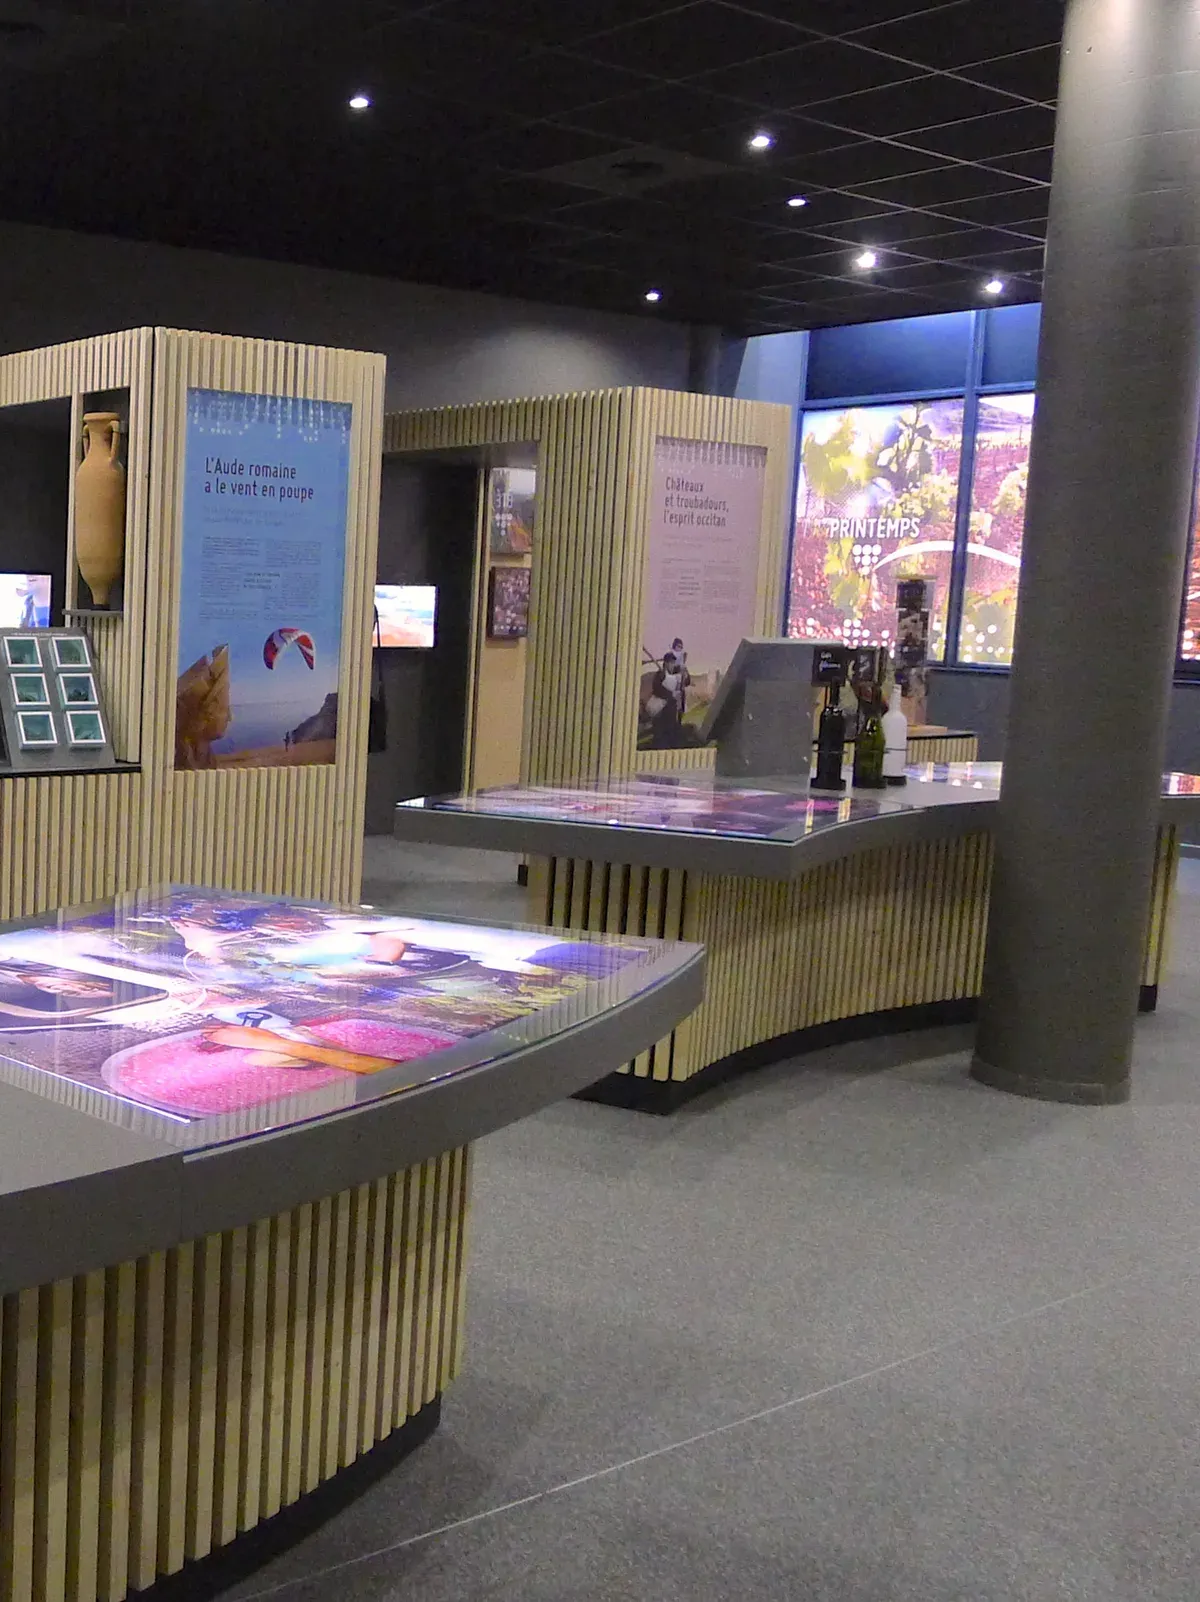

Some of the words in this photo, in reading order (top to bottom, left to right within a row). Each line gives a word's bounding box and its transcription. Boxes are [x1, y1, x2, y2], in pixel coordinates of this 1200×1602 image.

[205, 456, 245, 476] L'Aude
[248, 463, 297, 480] romaine
[204, 481, 212, 493] a
[215, 478, 227, 494] le
[230, 480, 257, 496] vent
[261, 484, 276, 497] en
[279, 486, 314, 503] poupe
[665, 476, 704, 492] Châteaux
[664, 493, 674, 507] et
[676, 494, 729, 513] troubadours,
[663, 509, 695, 527] l'esprit
[696, 513, 727, 527] occitan
[829, 517, 921, 539] PRINTEMPS
